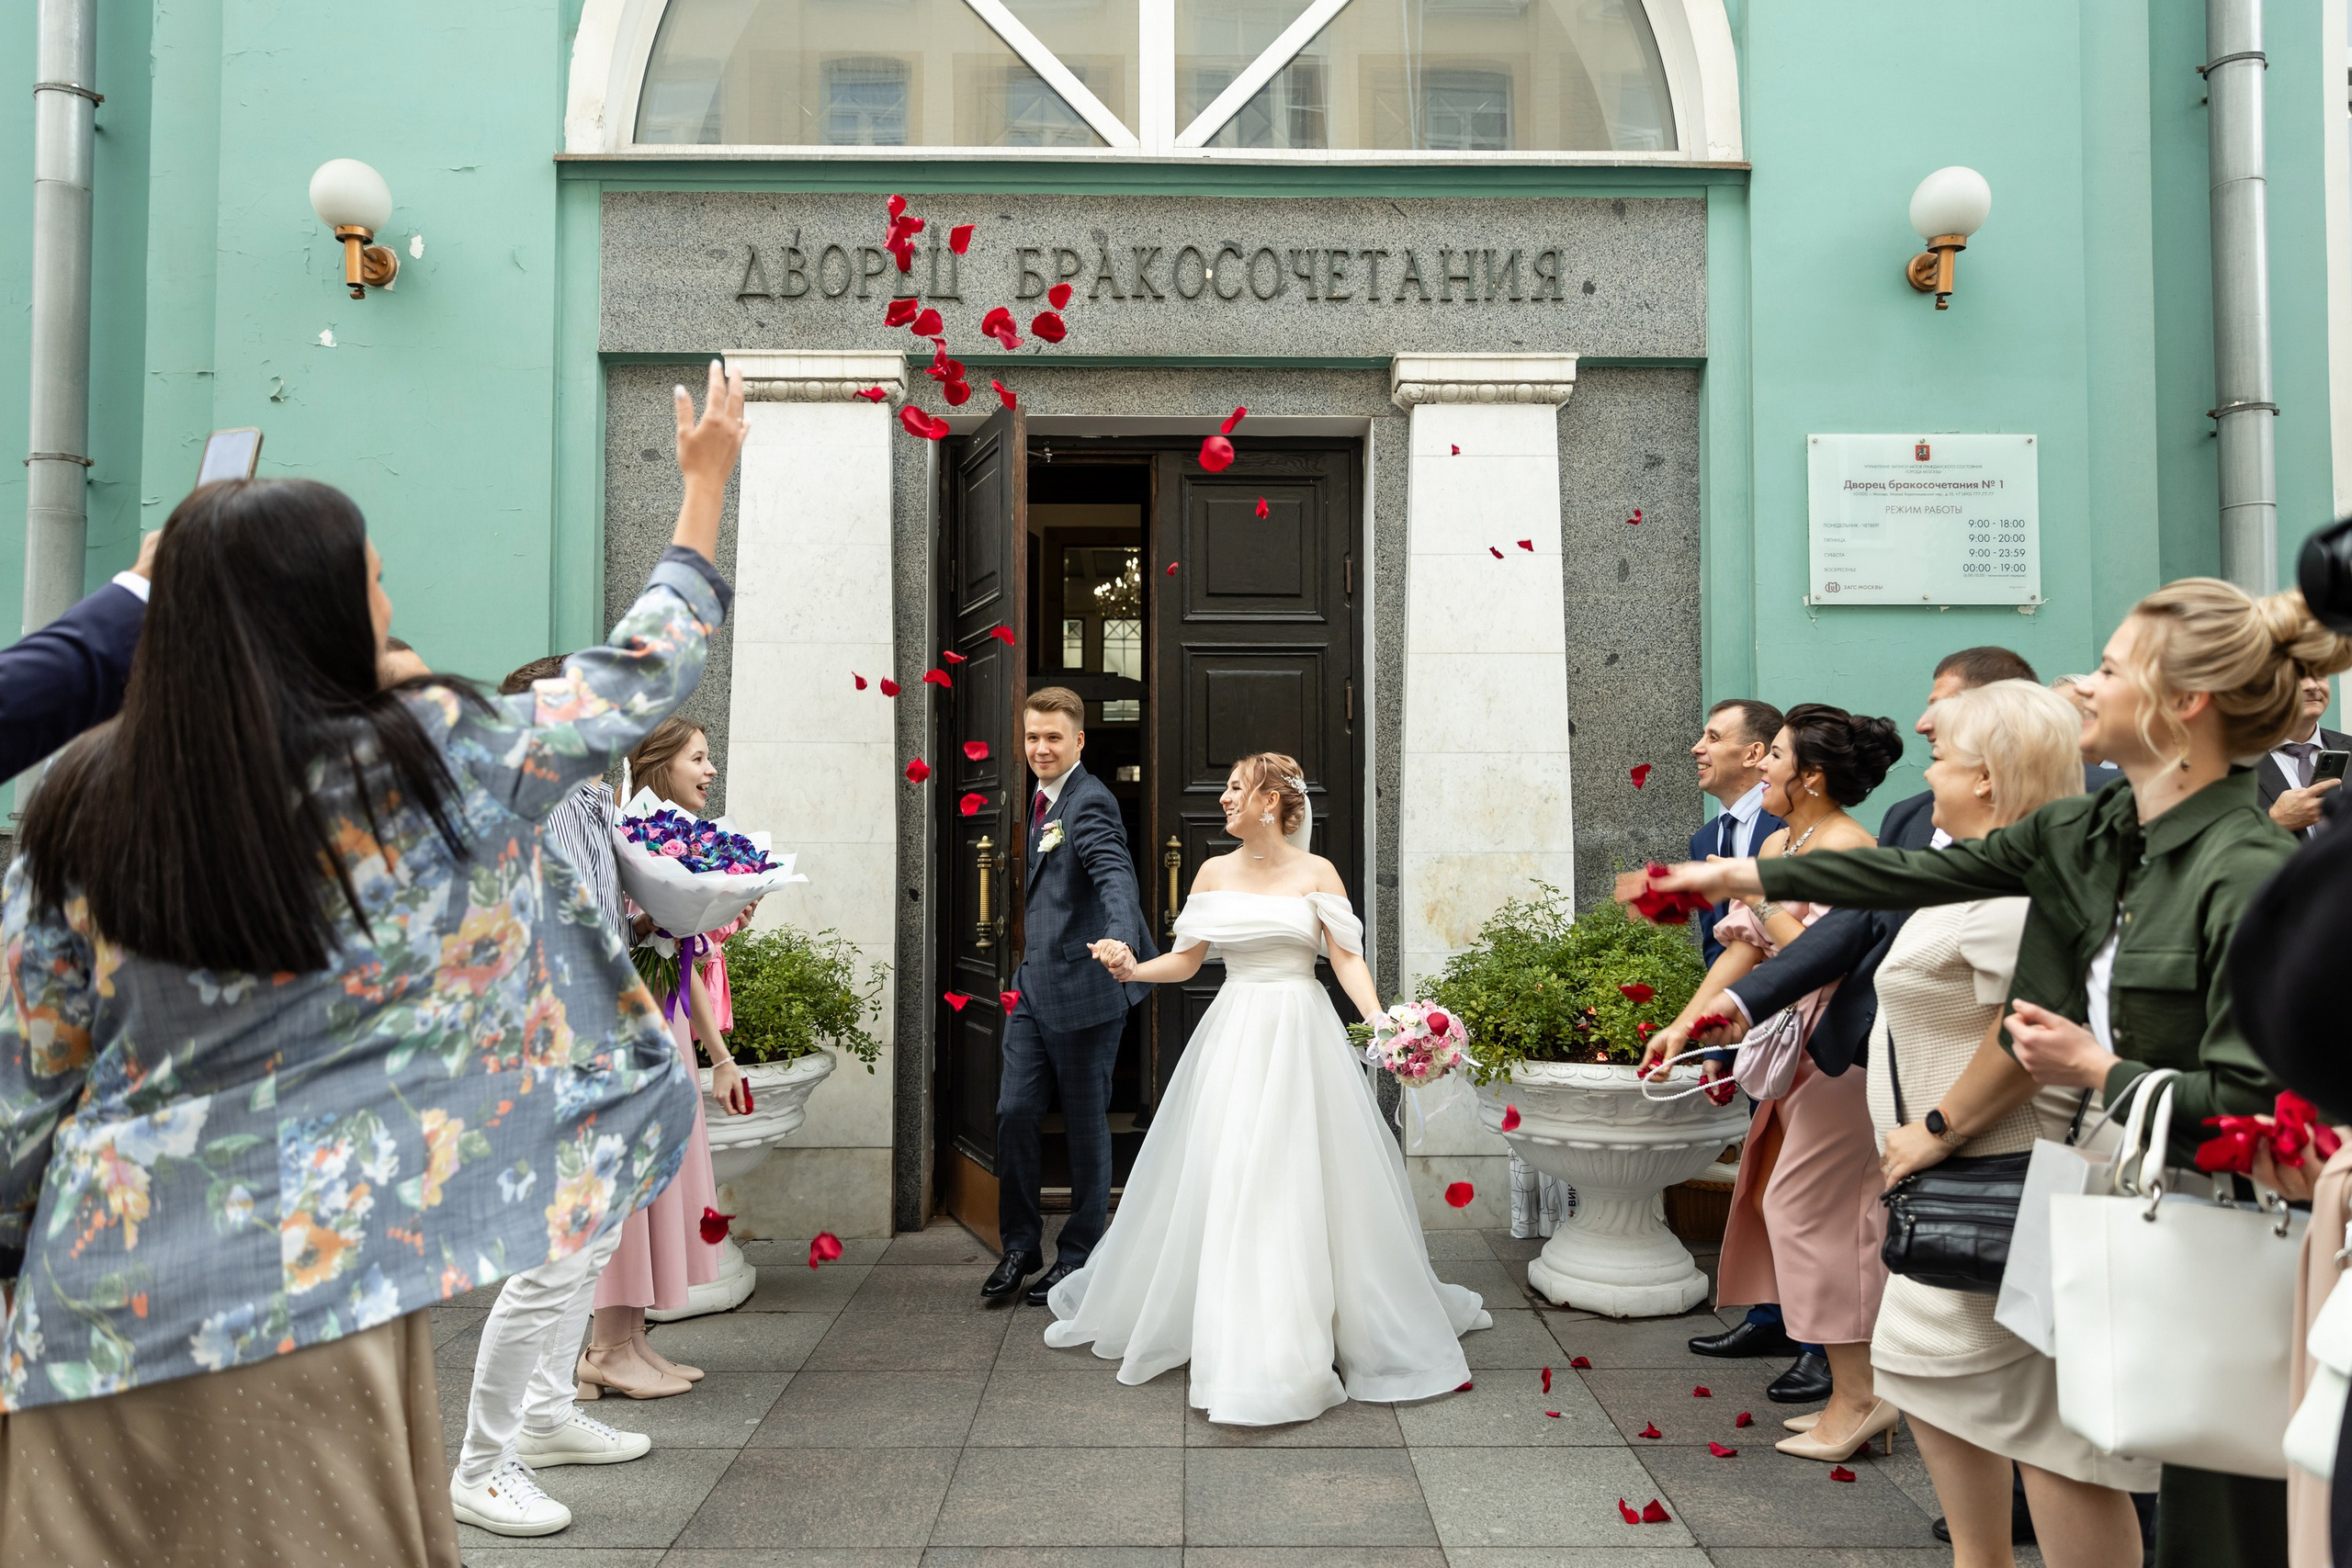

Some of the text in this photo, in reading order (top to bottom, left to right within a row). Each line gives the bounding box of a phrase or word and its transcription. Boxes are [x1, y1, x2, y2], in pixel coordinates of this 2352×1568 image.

[1015, 244, 1565, 299] БРАКОСОЧЕТАНИЯ
[1844, 479, 2004, 491] Дворец бракосочетания № 1
[1885, 505, 1962, 514] РЕЖИМ РАБОТЫ
[1968, 519, 1990, 528] 9:00
[2000, 519, 2025, 528] 18:00
[1968, 534, 1990, 543] 9:00
[1998, 534, 2025, 543] 20:00
[1969, 548, 1990, 558] 9:00
[1998, 548, 2026, 558] 23:59
[1962, 563, 1991, 572] 00:00
[2000, 563, 2026, 572] 19:00
